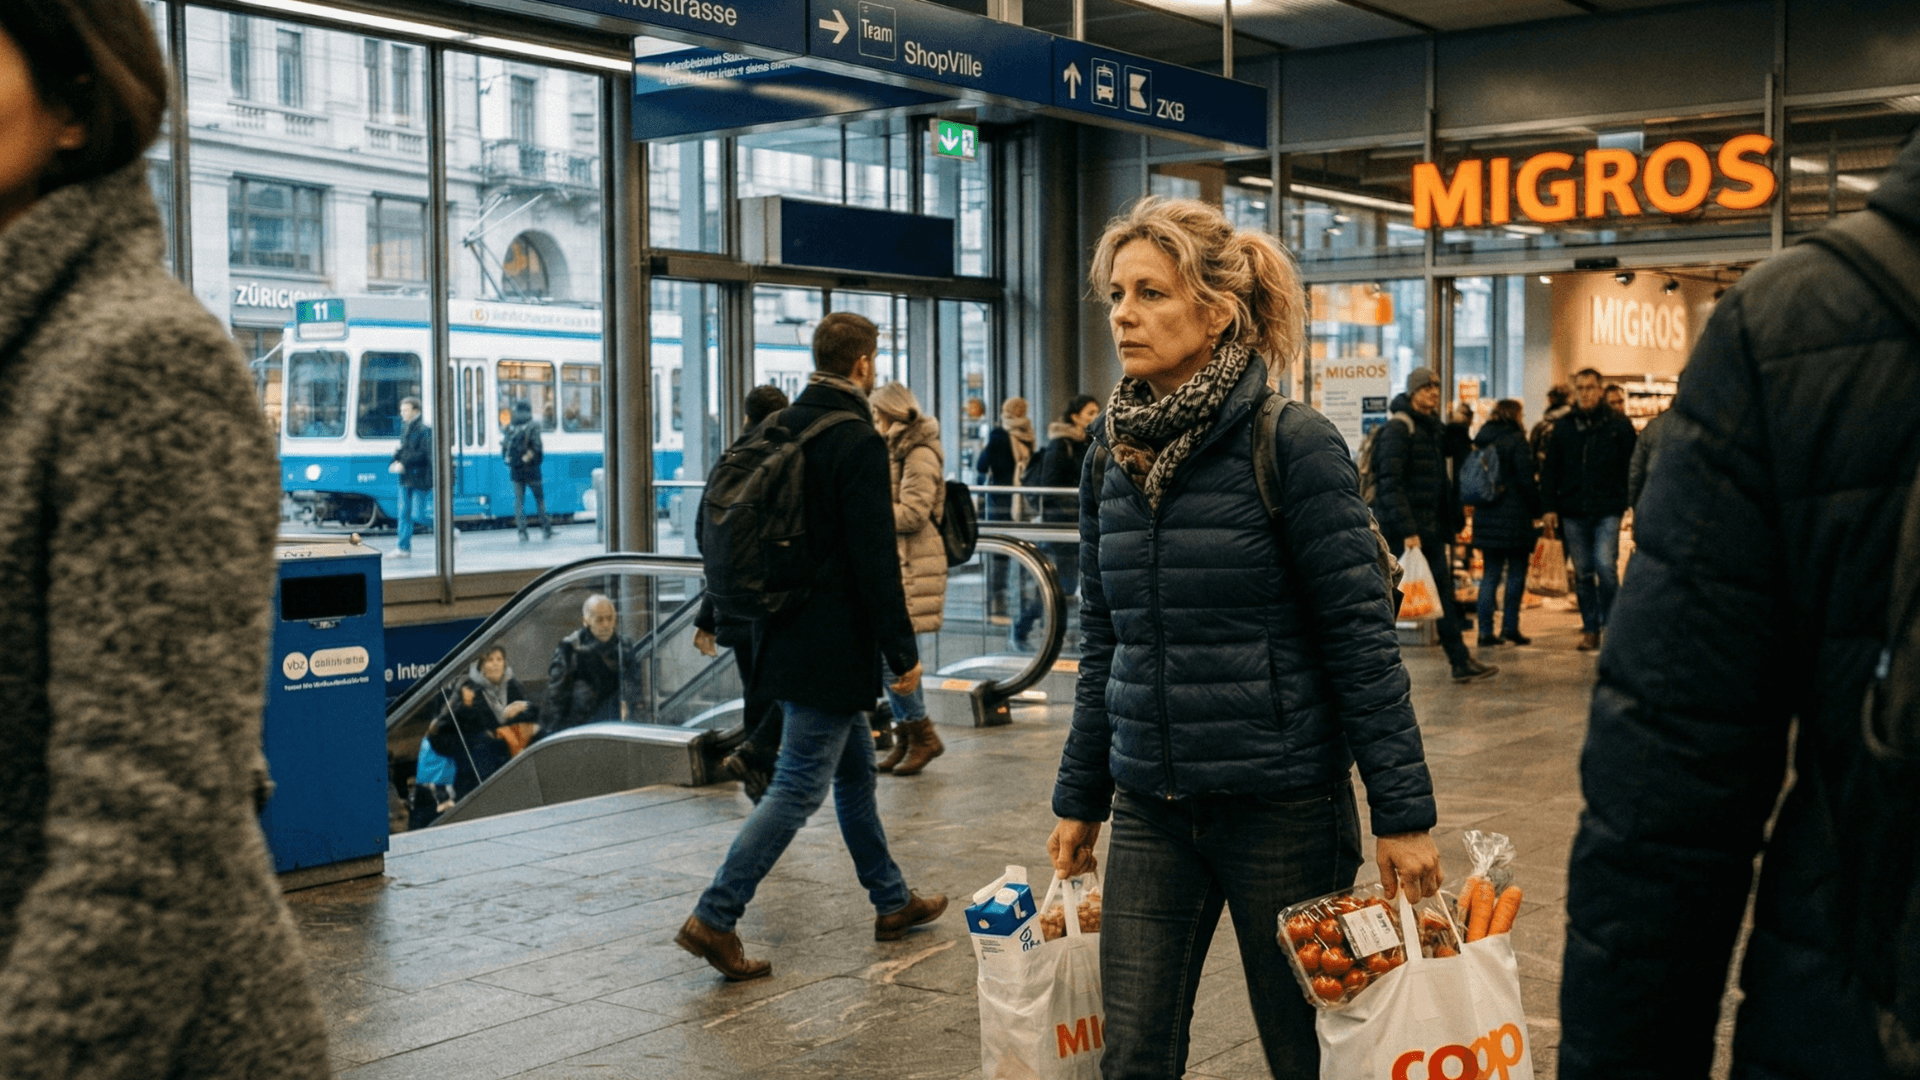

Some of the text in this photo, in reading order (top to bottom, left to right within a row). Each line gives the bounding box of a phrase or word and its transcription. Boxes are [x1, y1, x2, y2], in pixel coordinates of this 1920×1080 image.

[904, 40, 983, 77] ShopVille
[1156, 98, 1185, 122] ZKB
[1412, 133, 1776, 230] MIGROS
[313, 301, 328, 321] 11
[1594, 295, 1685, 350] MIGROS
[1325, 364, 1387, 379] MIGROS
[287, 660, 306, 671] vbz
[1056, 1014, 1105, 1060] MI
[1391, 1022, 1524, 1080] coop
